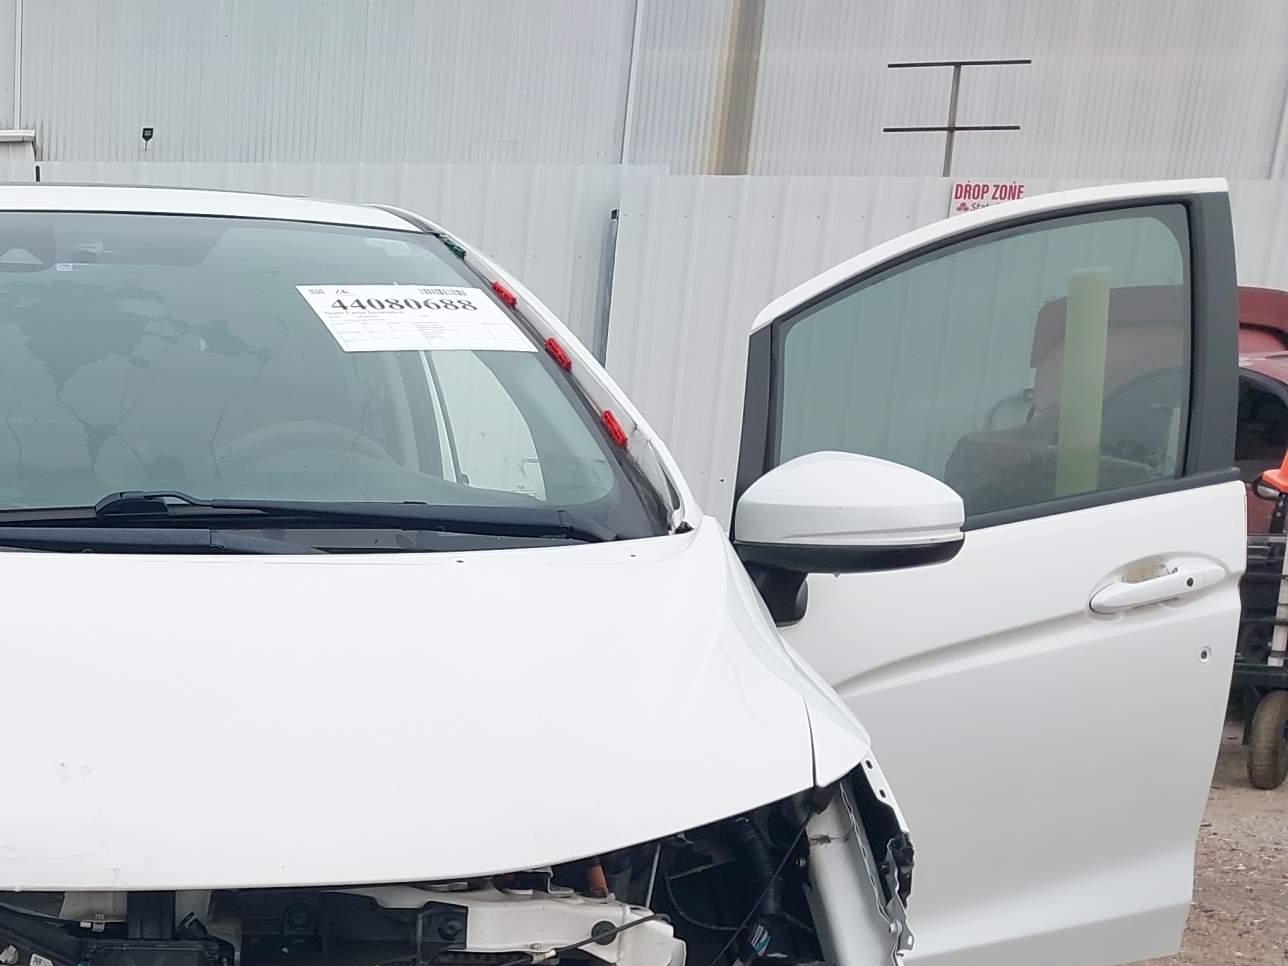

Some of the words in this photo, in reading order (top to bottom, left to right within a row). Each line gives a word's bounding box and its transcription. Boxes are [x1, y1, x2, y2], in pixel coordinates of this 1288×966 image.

[955, 184, 989, 199] DROP
[992, 185, 1024, 200] ZONE
[331, 298, 478, 312] 44080688
